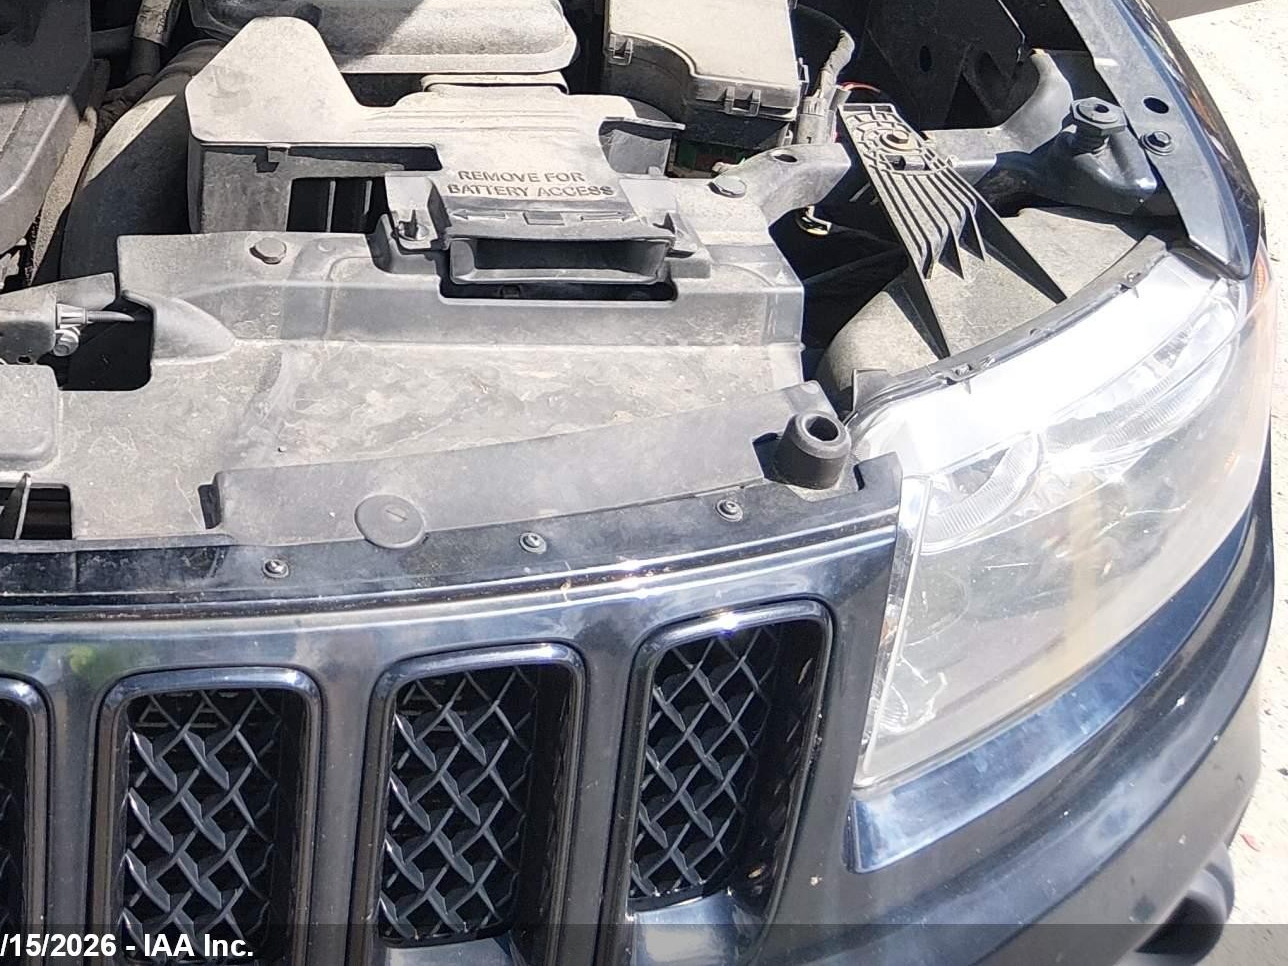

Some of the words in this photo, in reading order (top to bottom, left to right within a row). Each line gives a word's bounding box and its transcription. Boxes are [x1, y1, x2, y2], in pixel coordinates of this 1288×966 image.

[457, 170, 543, 183] REMOVE
[543, 171, 586, 183] FOR
[446, 184, 530, 197] BATTERY
[536, 185, 615, 197] ACCESS
